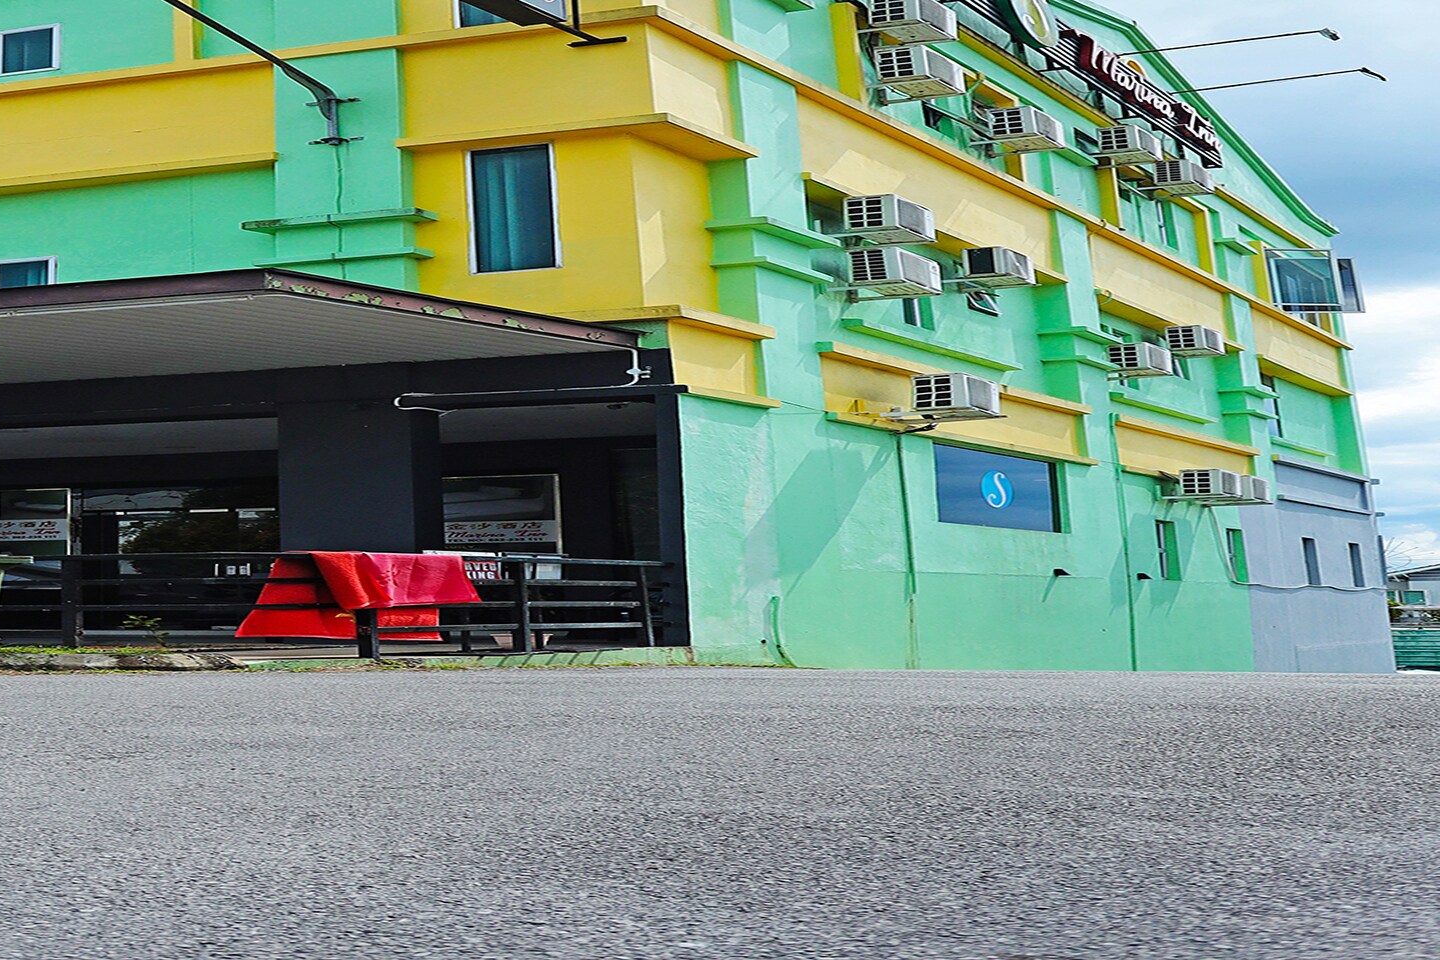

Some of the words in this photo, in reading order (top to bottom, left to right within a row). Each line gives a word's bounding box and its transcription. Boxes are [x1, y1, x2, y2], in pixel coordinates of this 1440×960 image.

[1062, 28, 1176, 121] Marina
[1171, 101, 1224, 155] Inn
[464, 561, 497, 571] RVED
